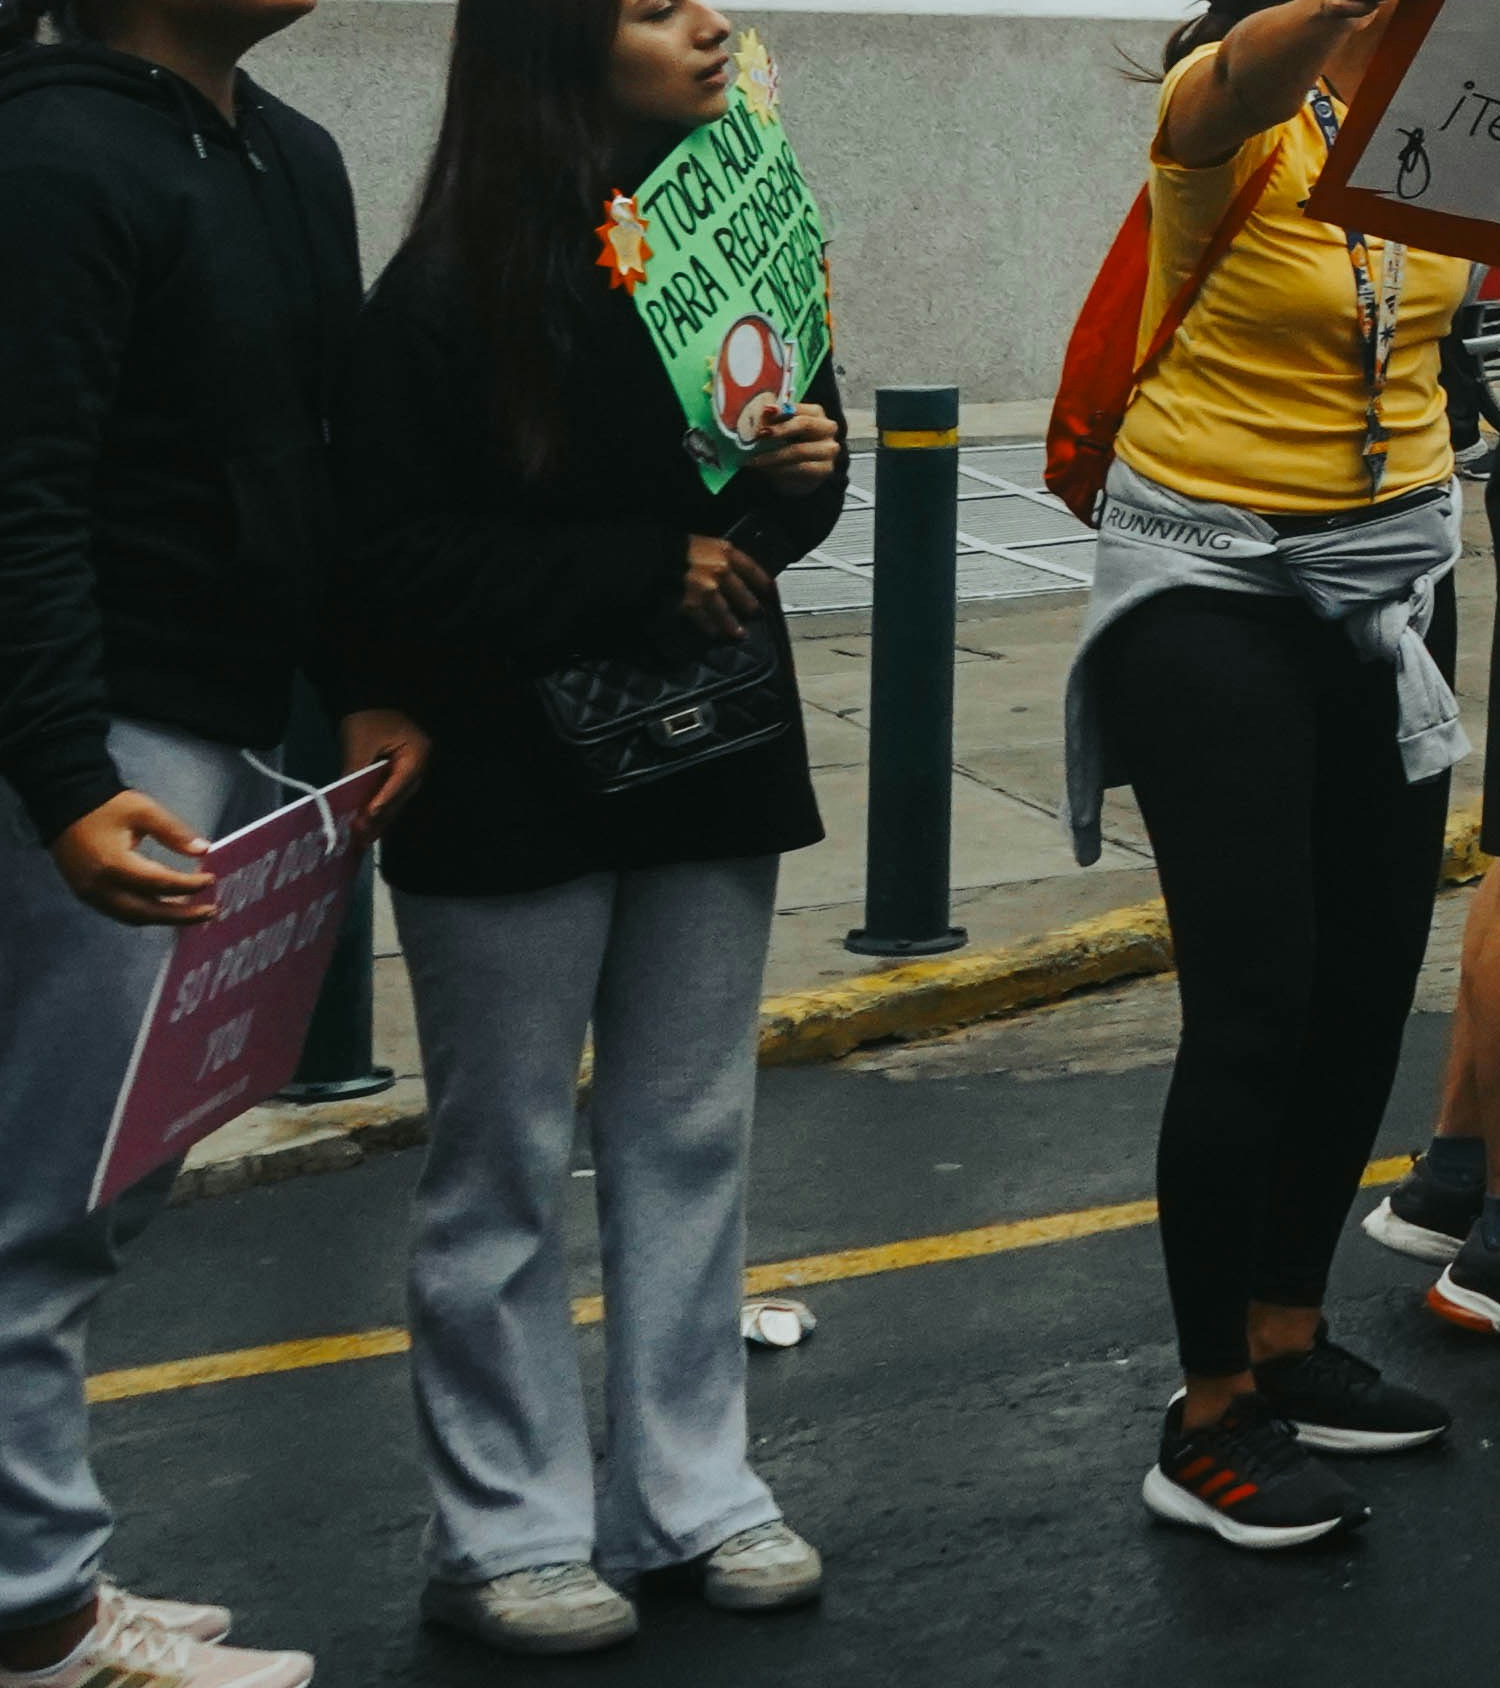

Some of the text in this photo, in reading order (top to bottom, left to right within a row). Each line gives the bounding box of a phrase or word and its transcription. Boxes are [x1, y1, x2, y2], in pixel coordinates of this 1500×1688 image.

[642, 153, 726, 251] TOCA
[645, 140, 806, 360] PARA RECARGAR
[1105, 506, 1234, 551] RUNNING
